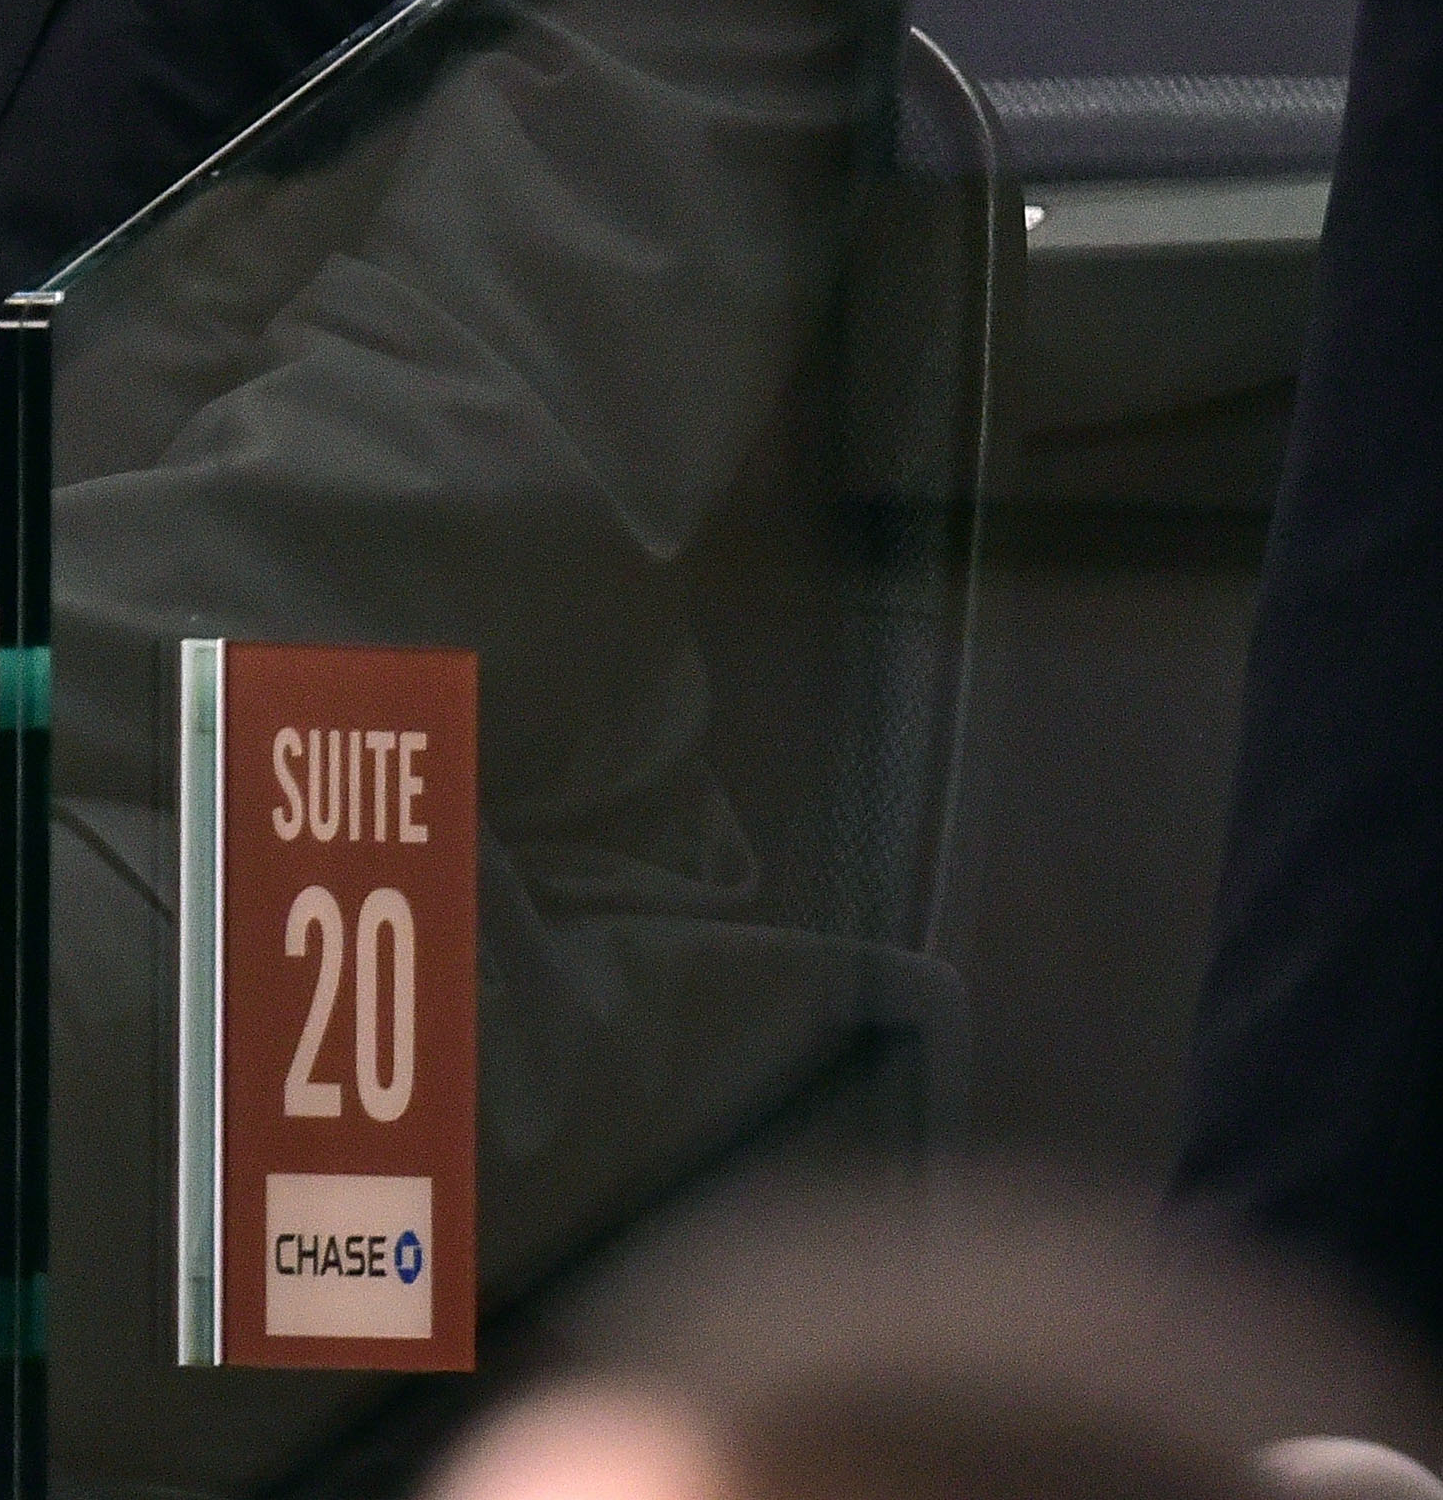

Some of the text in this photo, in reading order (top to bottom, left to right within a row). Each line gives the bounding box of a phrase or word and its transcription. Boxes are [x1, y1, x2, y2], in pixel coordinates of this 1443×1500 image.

[272, 727, 428, 843] SUITE
[284, 885, 416, 1122] 20
[275, 1233, 387, 1278] CHASE
